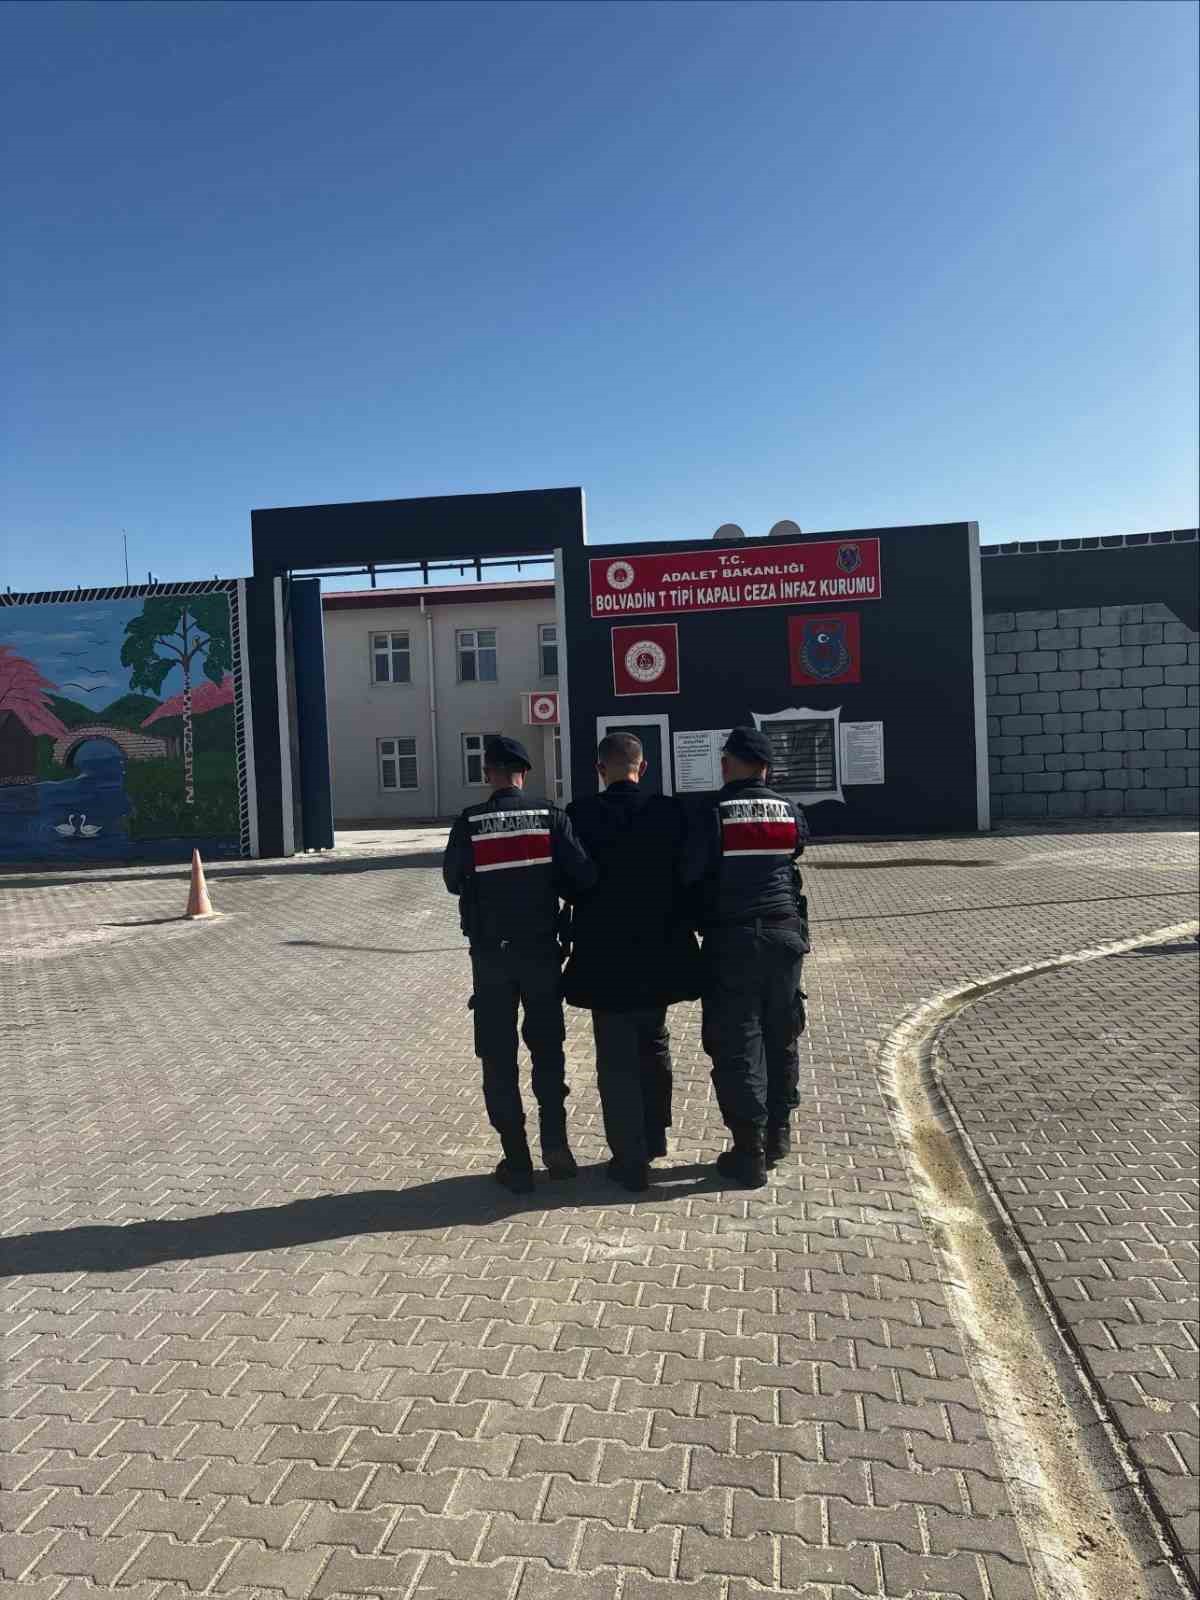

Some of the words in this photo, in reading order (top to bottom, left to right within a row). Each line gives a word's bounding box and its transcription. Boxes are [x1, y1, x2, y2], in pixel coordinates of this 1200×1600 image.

[718, 554, 745, 565] T.C.
[662, 569, 718, 583] ADALET
[722, 562, 805, 578] BAKANLIĞI
[596, 588, 656, 611] BOLVADİN
[658, 590, 667, 608] T
[670, 585, 694, 607] TİPİ
[697, 585, 741, 605] KAPALI
[744, 583, 777, 601] CEZA
[780, 578, 817, 599] İNFAZ
[820, 576, 876, 597] KURUMU
[728, 803, 789, 818] JANDARMA
[478, 815, 542, 834] JANDARMA
